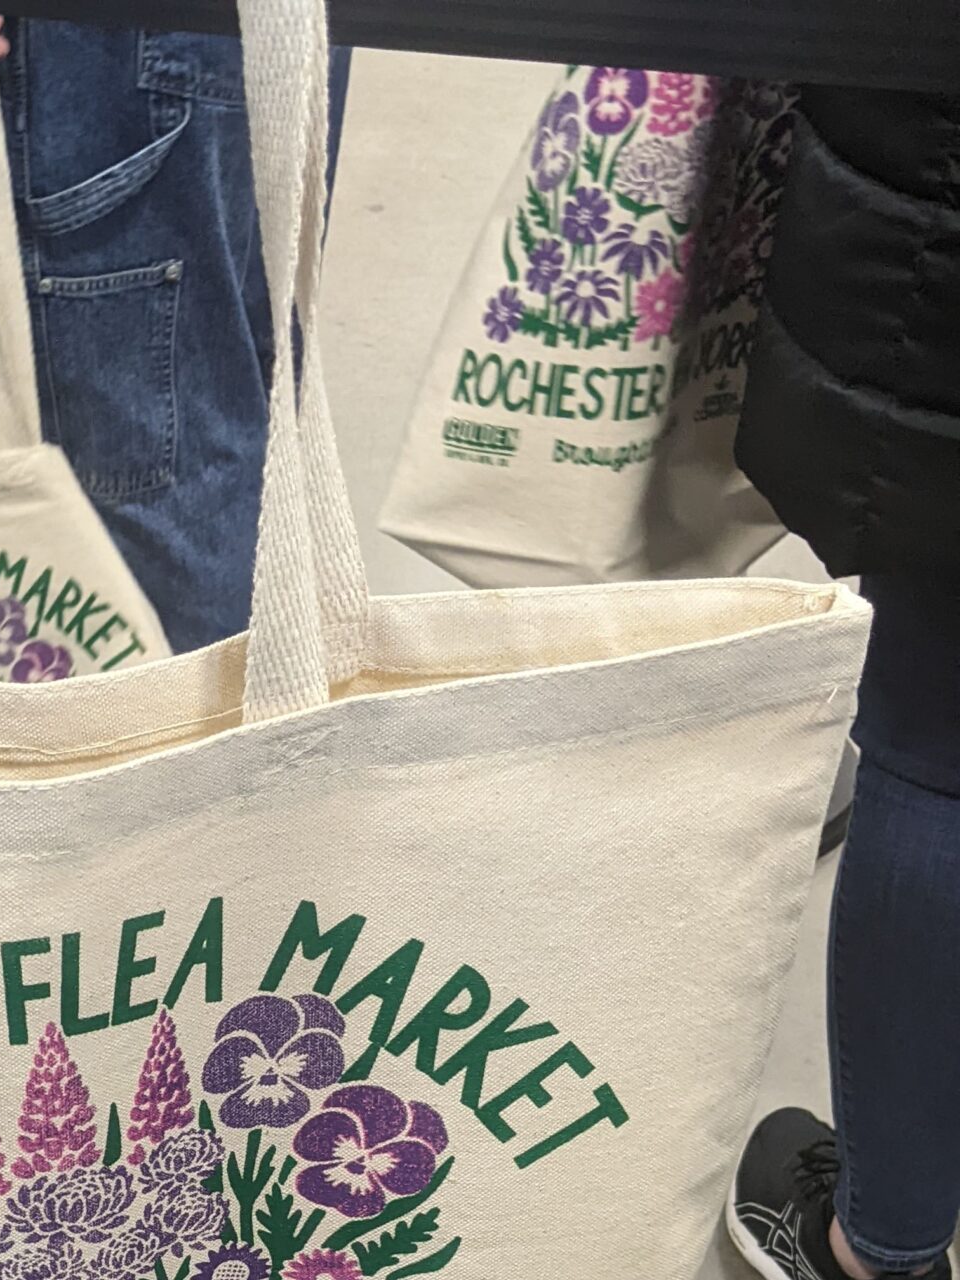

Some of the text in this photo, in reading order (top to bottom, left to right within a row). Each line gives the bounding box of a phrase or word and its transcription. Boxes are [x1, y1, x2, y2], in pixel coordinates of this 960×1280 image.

[452, 347, 669, 422] ROCHESTER
[0, 896, 223, 1046] FLEA
[258, 899, 630, 1170] MARKET
